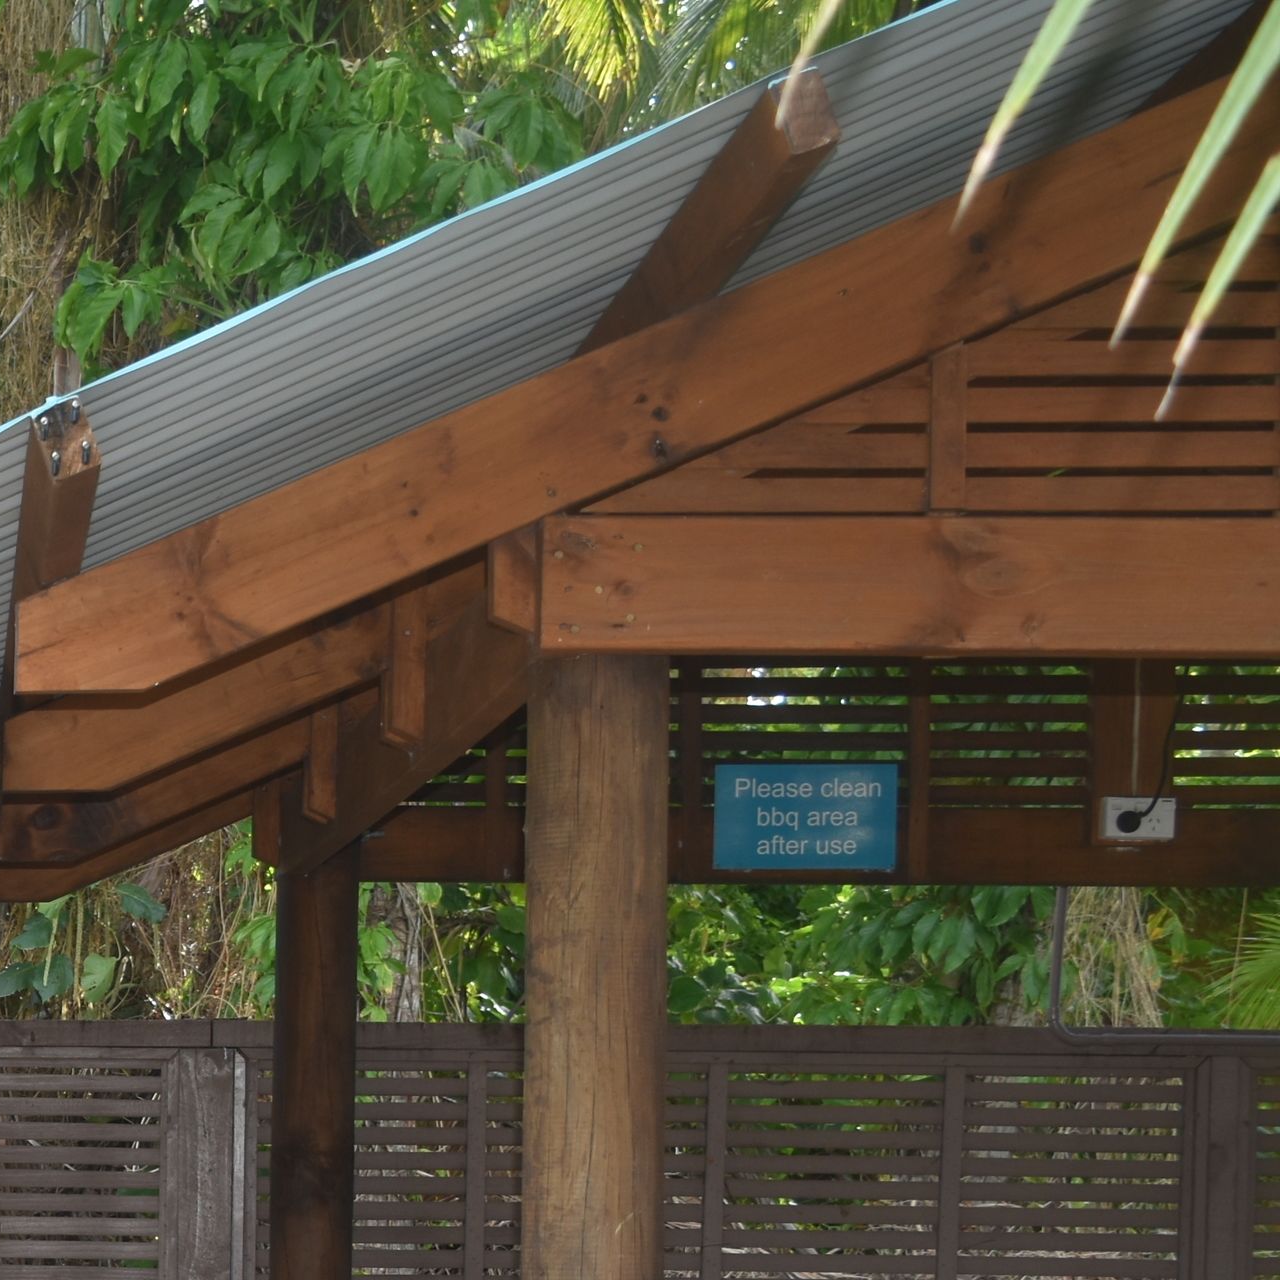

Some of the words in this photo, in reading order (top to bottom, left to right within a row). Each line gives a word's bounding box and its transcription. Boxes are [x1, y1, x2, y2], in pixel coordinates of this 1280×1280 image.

[734, 778, 813, 798] Please
[820, 777, 882, 798] clean
[756, 806, 800, 831] bbq
[806, 810, 858, 827] area
[756, 835, 808, 855] after
[815, 839, 857, 855] use
